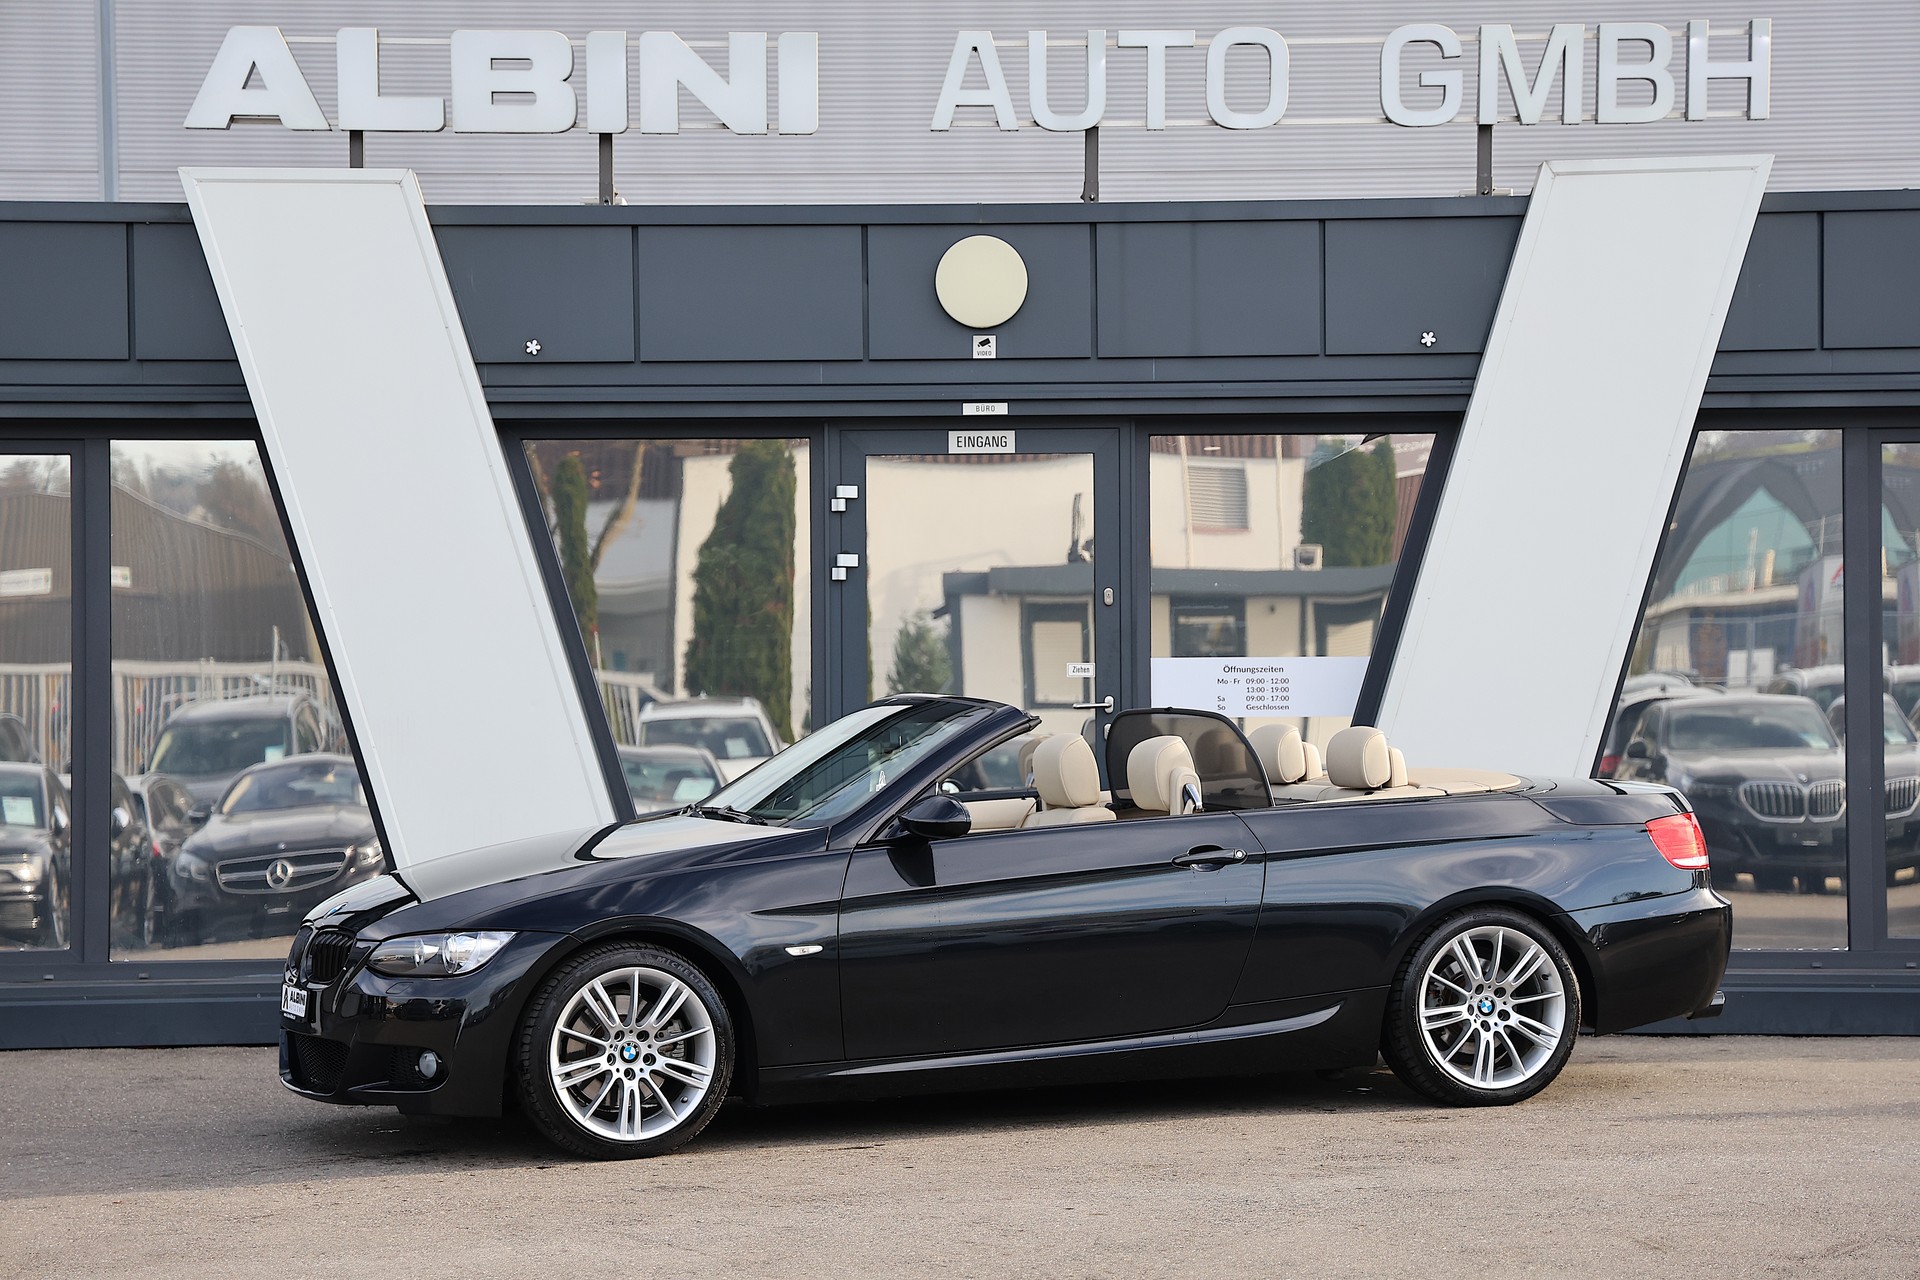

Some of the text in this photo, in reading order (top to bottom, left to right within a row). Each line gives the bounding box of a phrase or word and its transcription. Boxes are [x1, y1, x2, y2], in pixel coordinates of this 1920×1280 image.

[183, 18, 1772, 135] ALBINI AUTO GMBH
[975, 404, 996, 412] BÜRO
[957, 435, 1008, 448] EINGANG
[1223, 664, 1284, 674] Öffnungszeiten
[656, 956, 706, 989] MICHELIN
